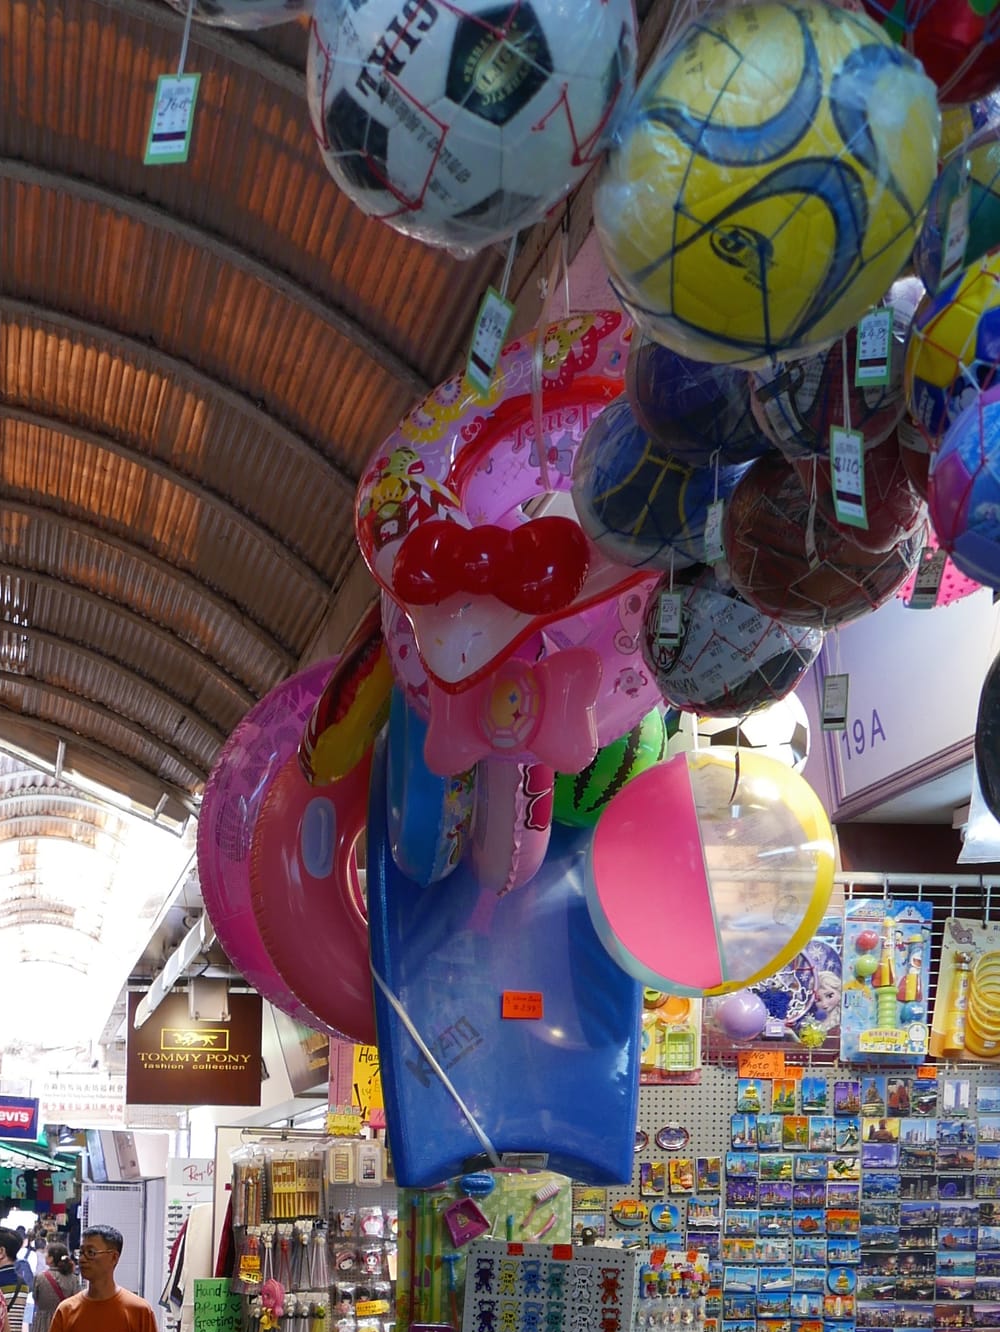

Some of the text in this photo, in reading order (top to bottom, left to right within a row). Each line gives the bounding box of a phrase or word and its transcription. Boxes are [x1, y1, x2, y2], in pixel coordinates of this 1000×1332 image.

[842, 708, 886, 760] 19A
[137, 1052, 251, 1063] TOMMY PONY
[194, 1316, 234, 1331] Greeting
